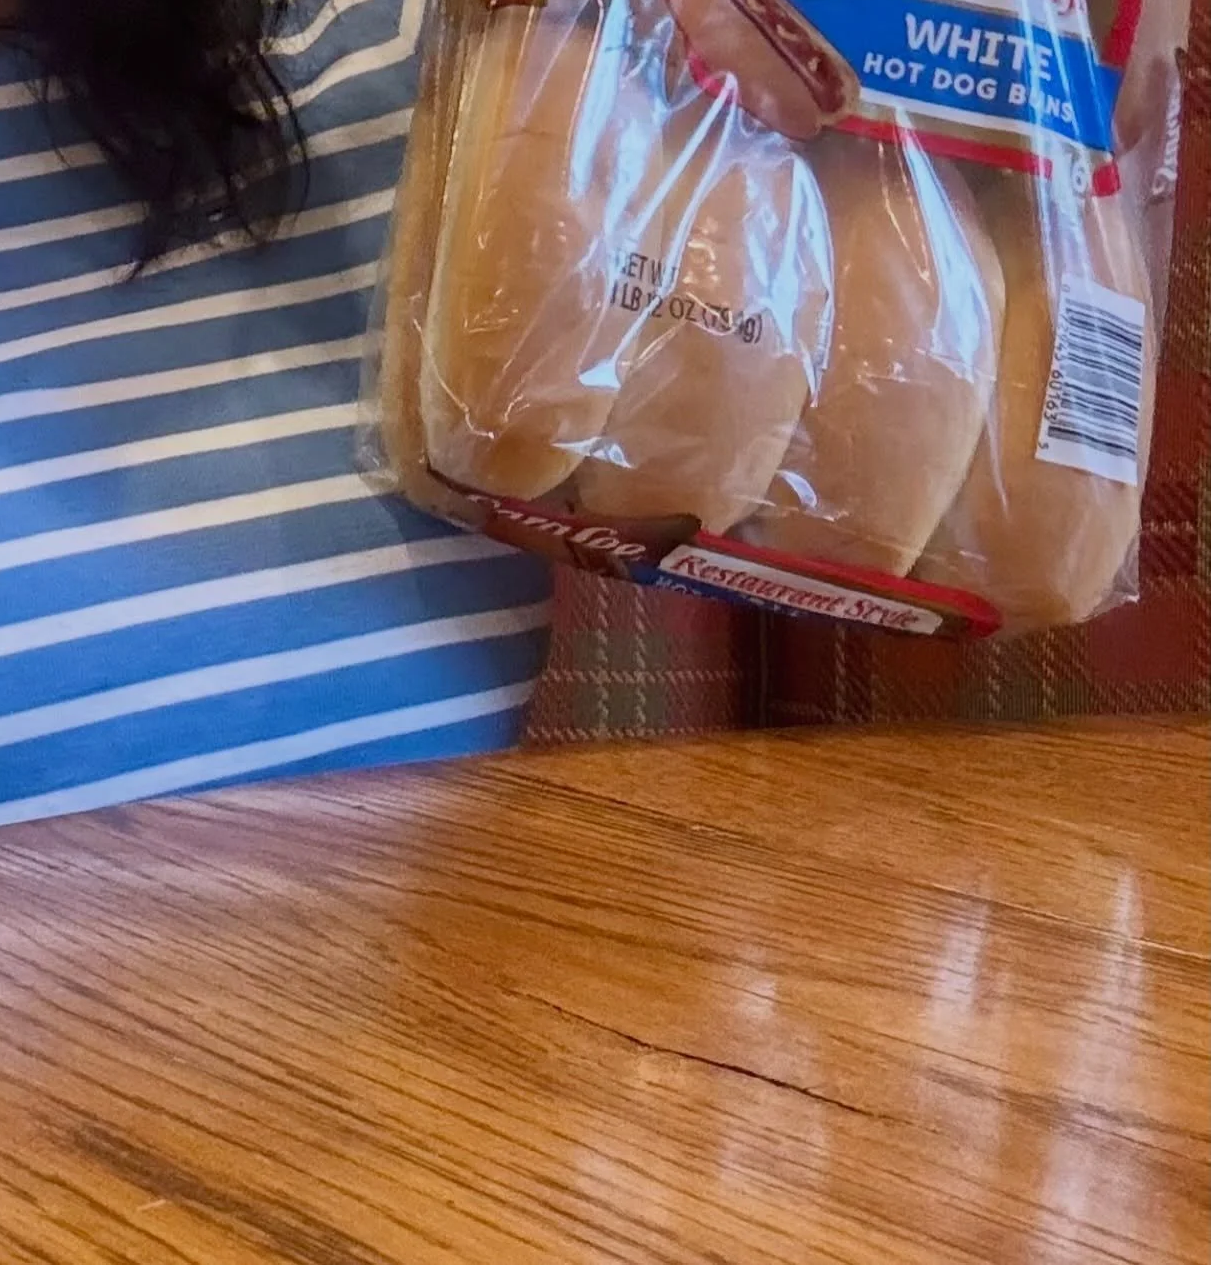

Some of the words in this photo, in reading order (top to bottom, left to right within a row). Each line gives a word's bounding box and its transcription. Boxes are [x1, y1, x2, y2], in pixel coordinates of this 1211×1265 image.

[905, 13, 1053, 81] WHITE
[863, 53, 926, 85] HOT
[932, 66, 998, 101] DOG
[620, 283, 643, 312] LB
[669, 294, 698, 323] OZ
[1043, 369, 1063, 423] 60163
[673, 553, 845, 615] Restaurant
